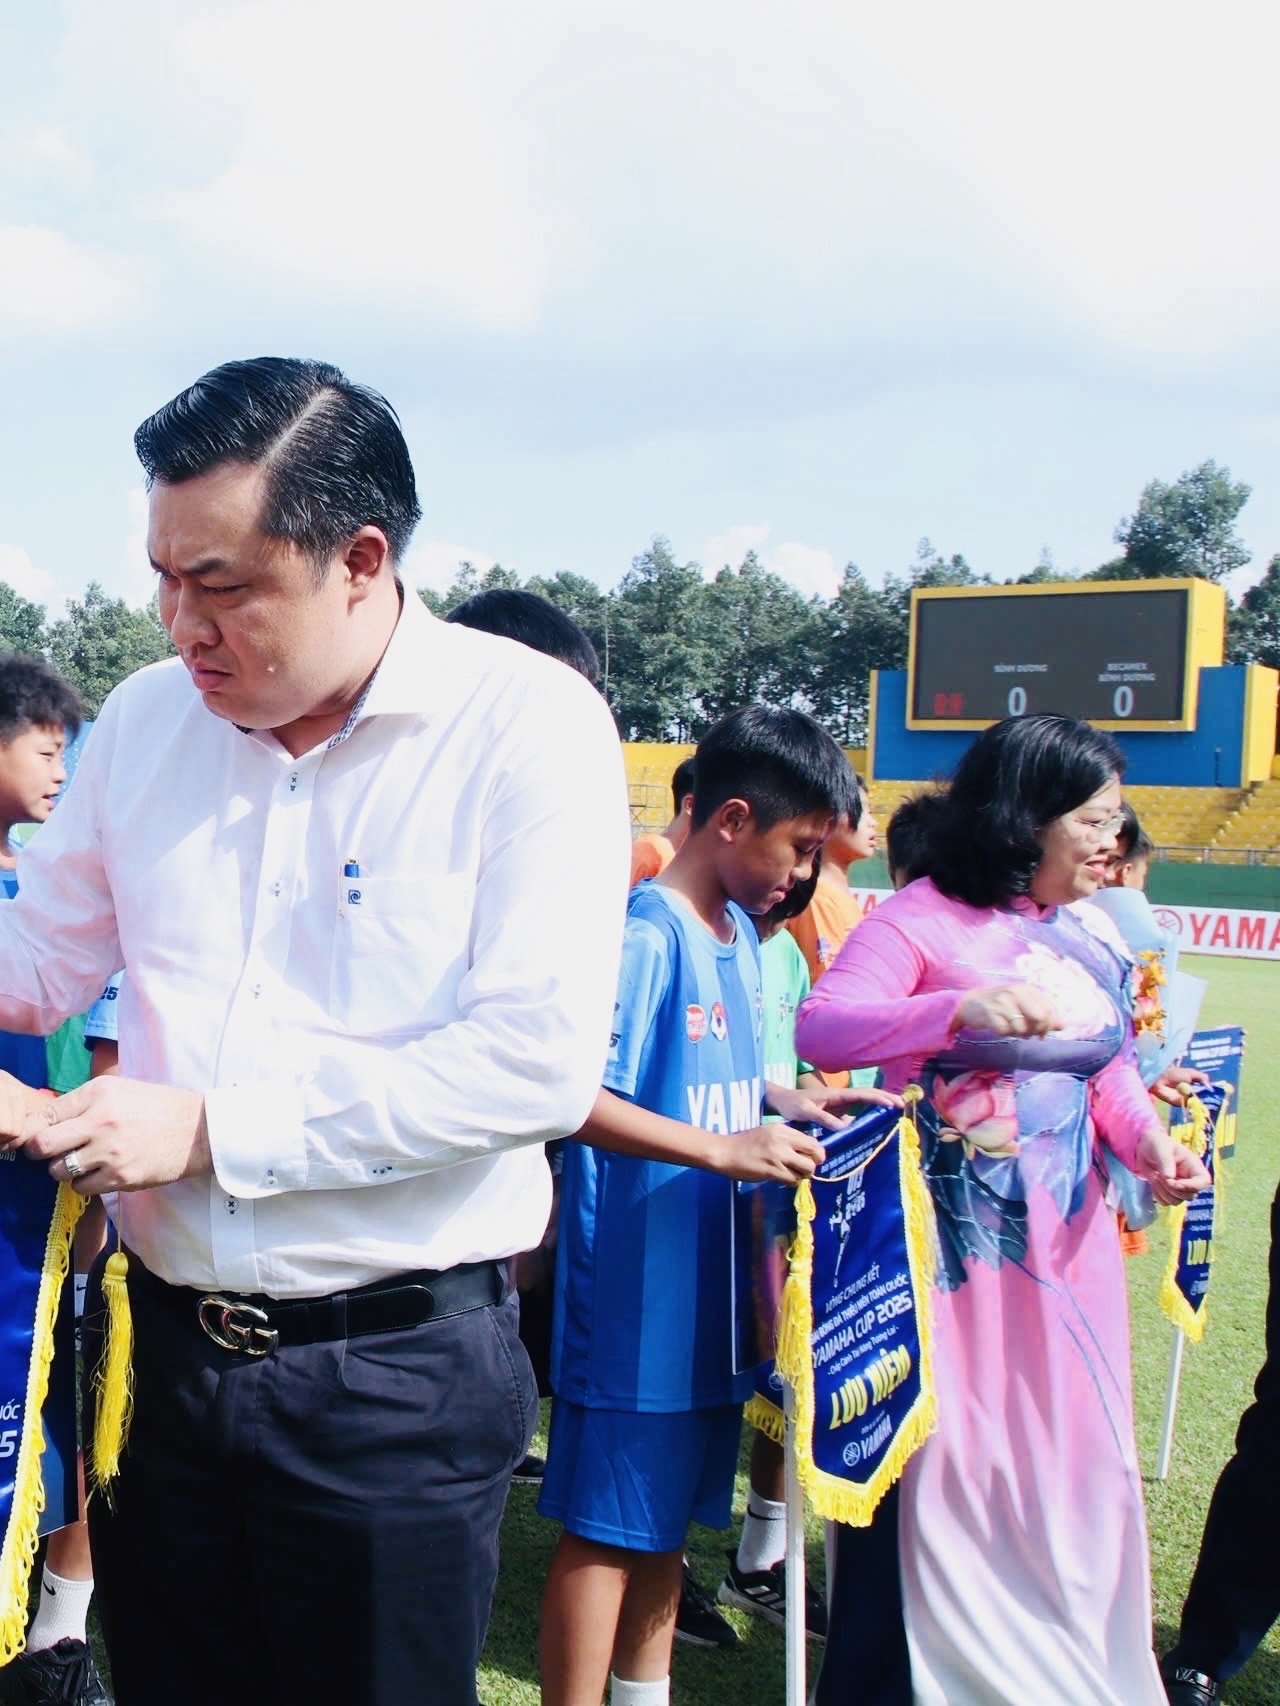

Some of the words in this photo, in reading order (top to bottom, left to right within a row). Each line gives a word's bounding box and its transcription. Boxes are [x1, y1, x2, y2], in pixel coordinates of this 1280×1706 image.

[1008, 686, 1027, 717] 0
[1113, 685, 1134, 718] 0
[811, 1325, 856, 1369] YAMAHA
[855, 1310, 876, 1339] CUP
[875, 1290, 913, 1324] 2025
[860, 1414, 893, 1460] YAMAHA
